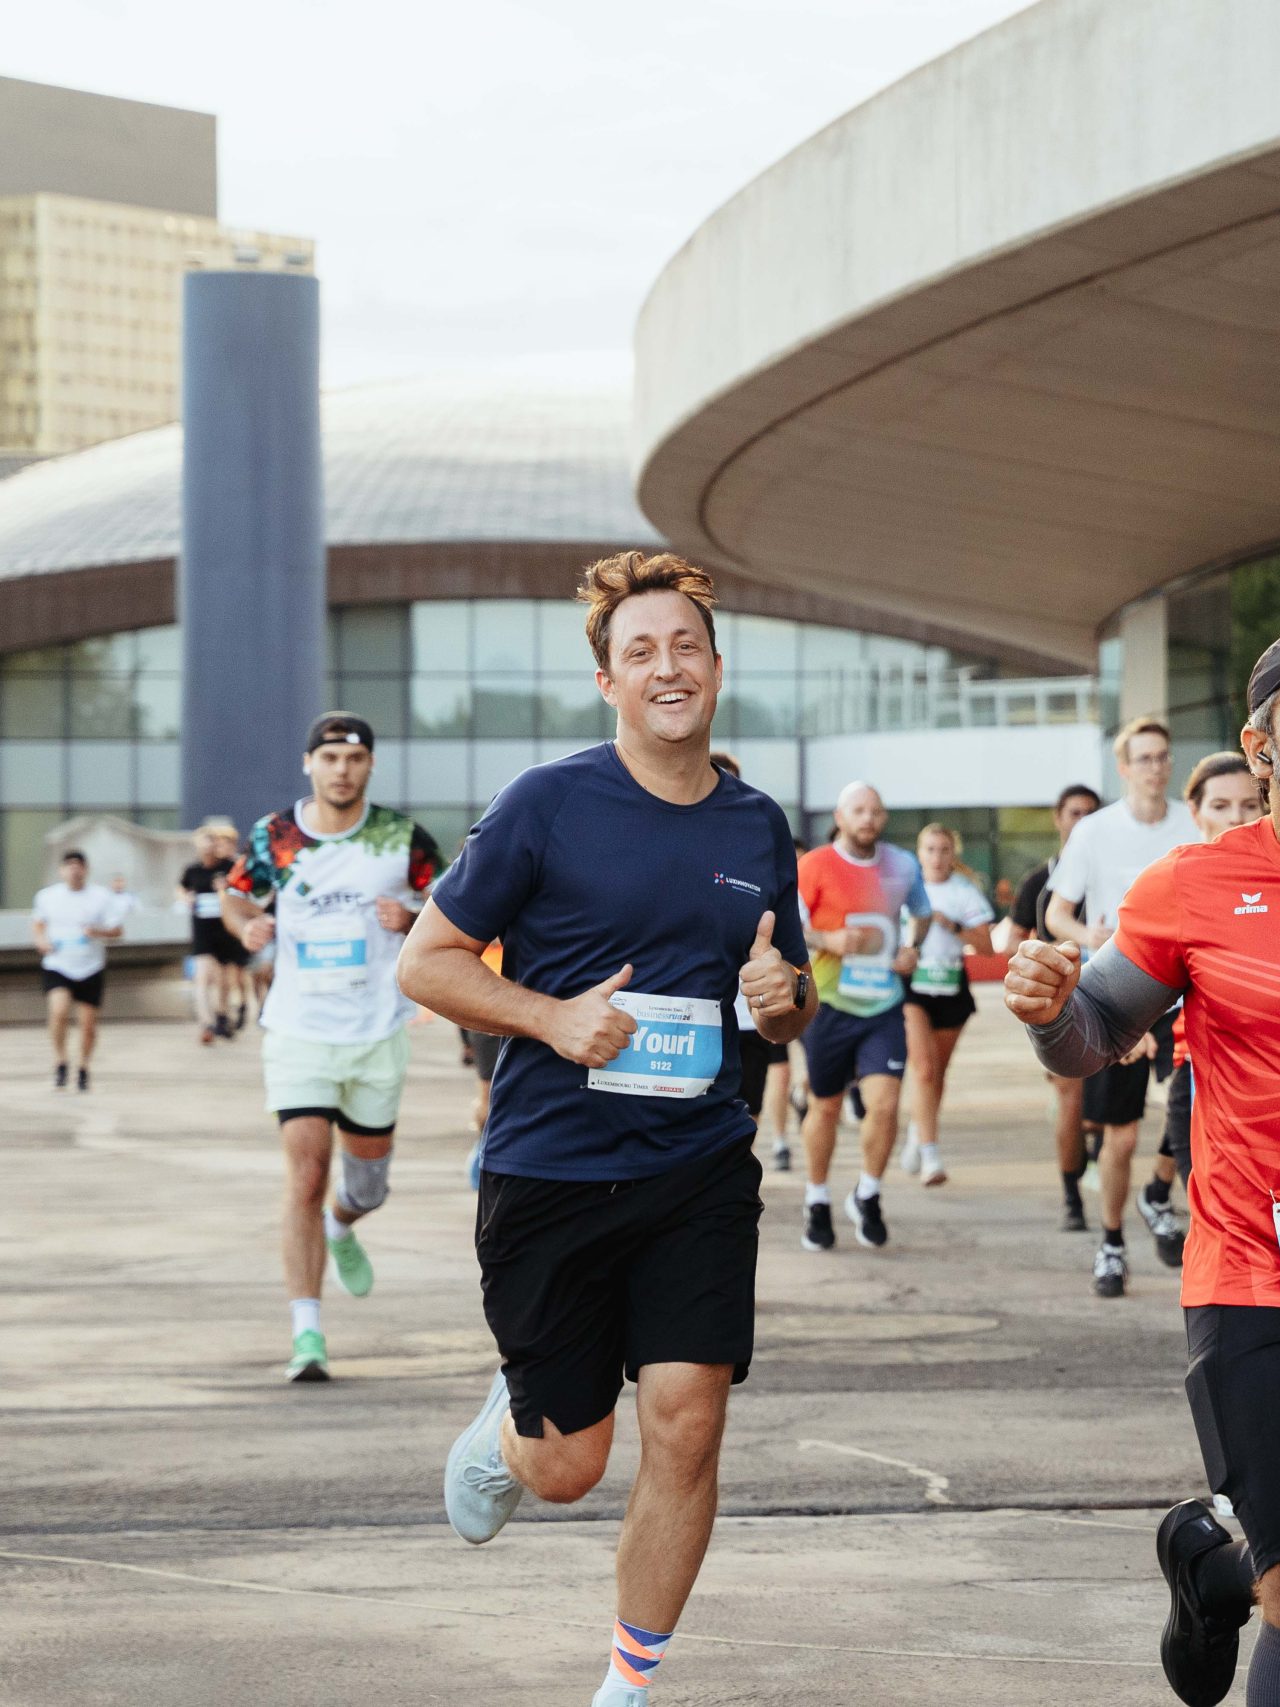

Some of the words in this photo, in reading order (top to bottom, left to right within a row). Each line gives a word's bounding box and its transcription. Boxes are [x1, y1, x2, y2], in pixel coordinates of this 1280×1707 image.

[1234, 904, 1268, 914] erima
[632, 1026, 696, 1056] Youri
[650, 1061, 672, 1072] 5122
